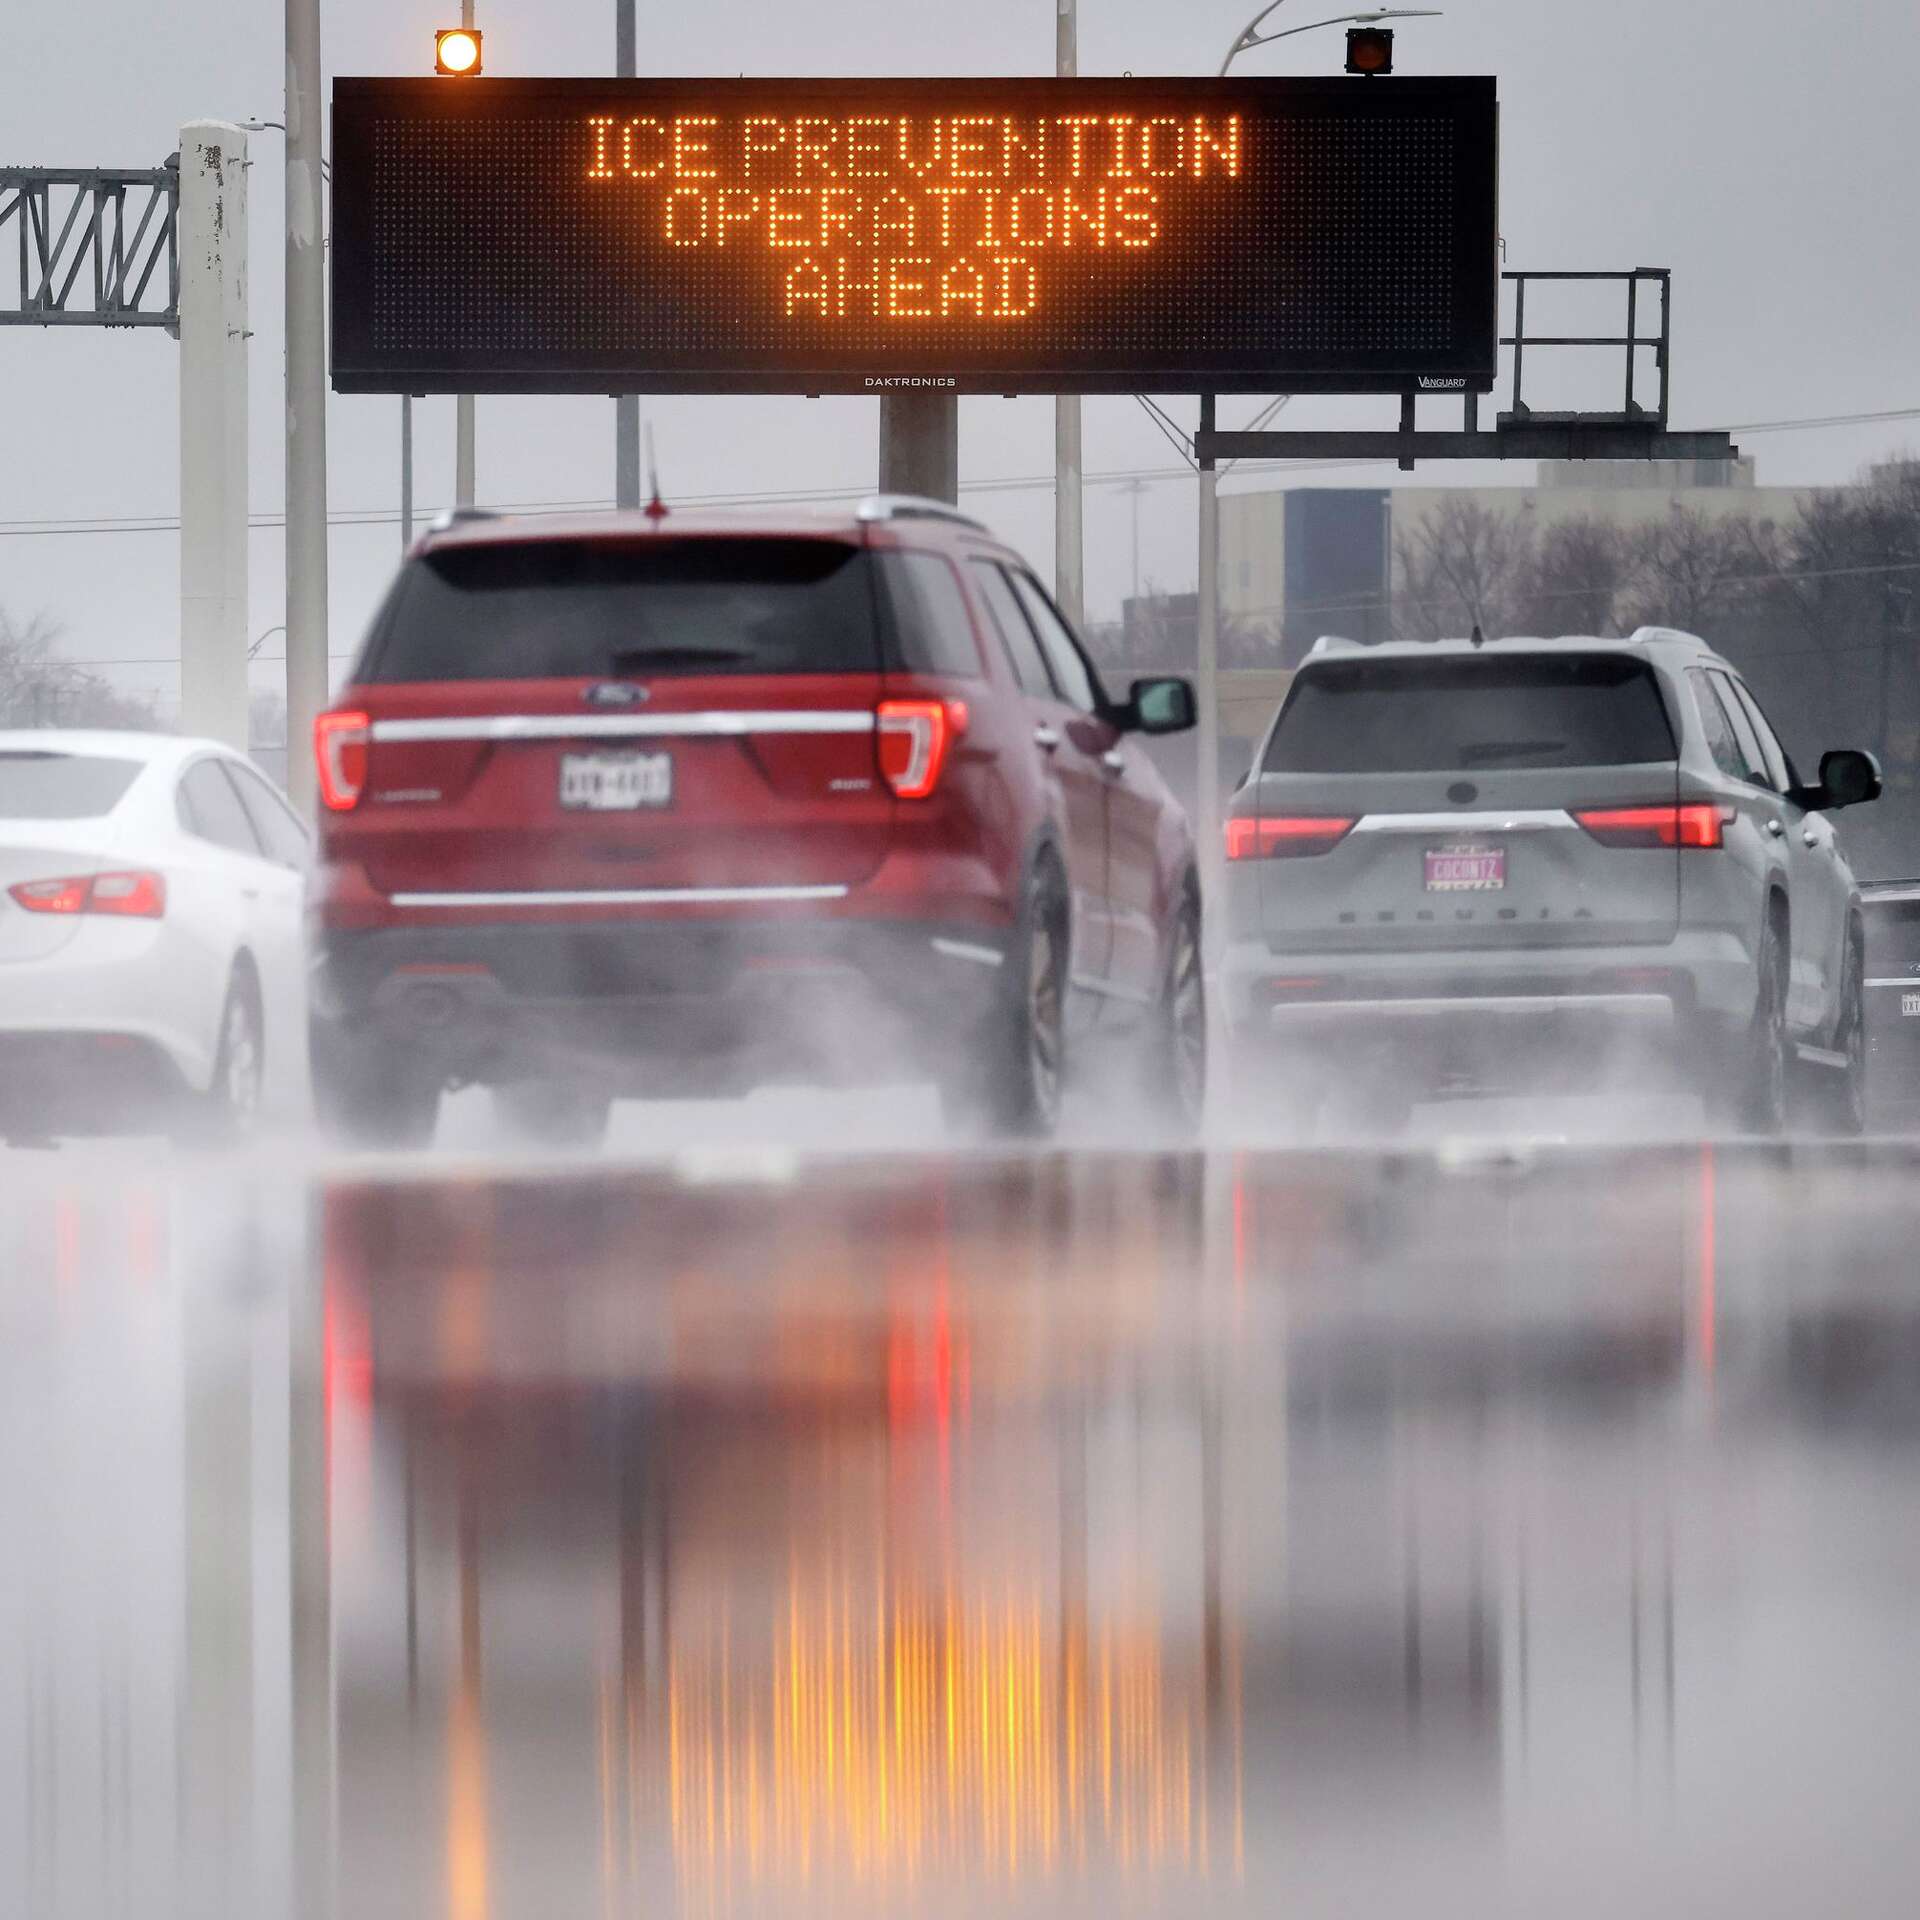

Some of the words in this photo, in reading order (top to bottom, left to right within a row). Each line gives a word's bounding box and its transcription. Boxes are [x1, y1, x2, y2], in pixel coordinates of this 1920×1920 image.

[587, 117, 718, 179] ICE
[743, 117, 1239, 179] PREVENTION
[664, 186, 1159, 248] OPERATIONS
[785, 256, 1036, 317] AHEAD
[864, 377, 956, 387] DAKTRONICS
